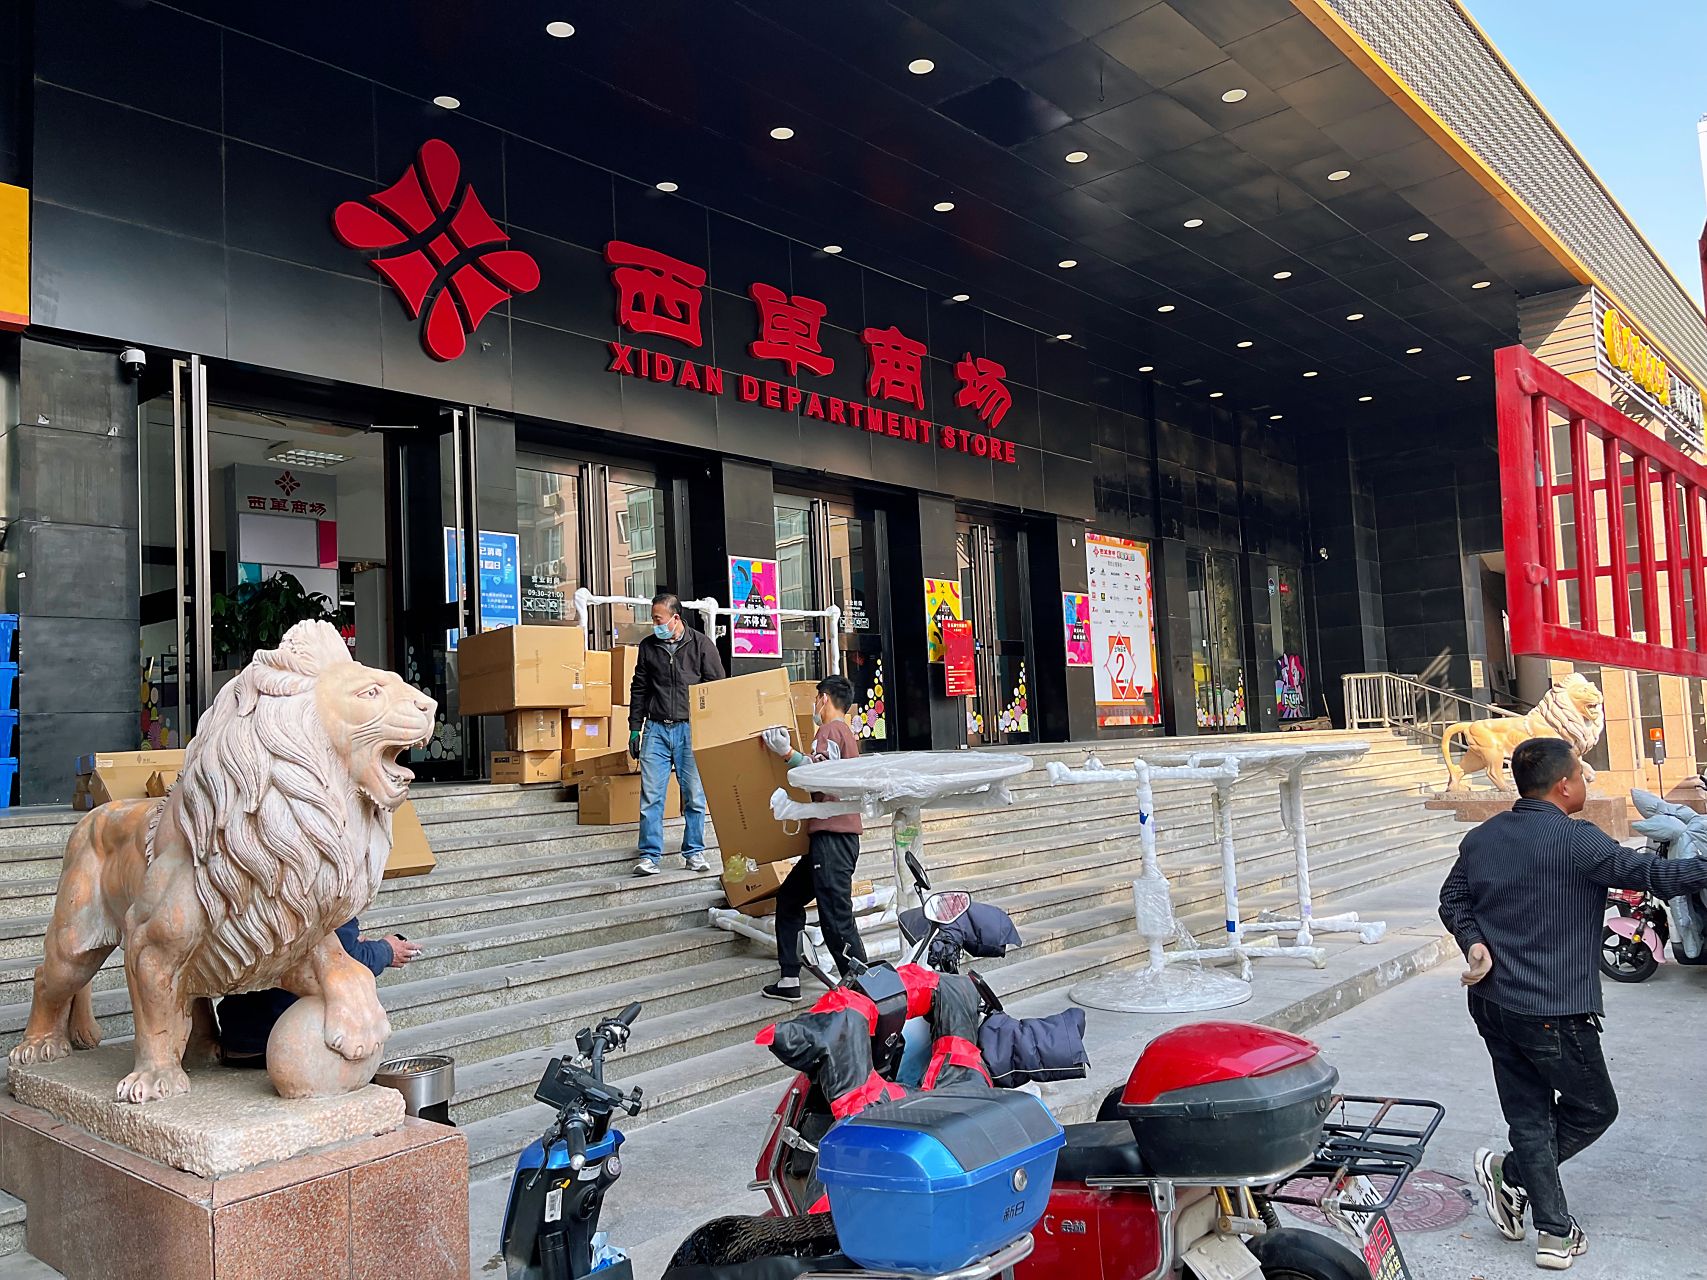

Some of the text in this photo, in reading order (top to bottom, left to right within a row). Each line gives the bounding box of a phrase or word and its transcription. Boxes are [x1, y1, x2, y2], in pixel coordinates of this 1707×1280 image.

[607, 342, 1017, 463] XIDAN DEPARTMENT STORE
[743, 615, 768, 628] 不停业
[1116, 653, 1125, 683] 2
[1002, 1200, 1026, 1223] 新日
